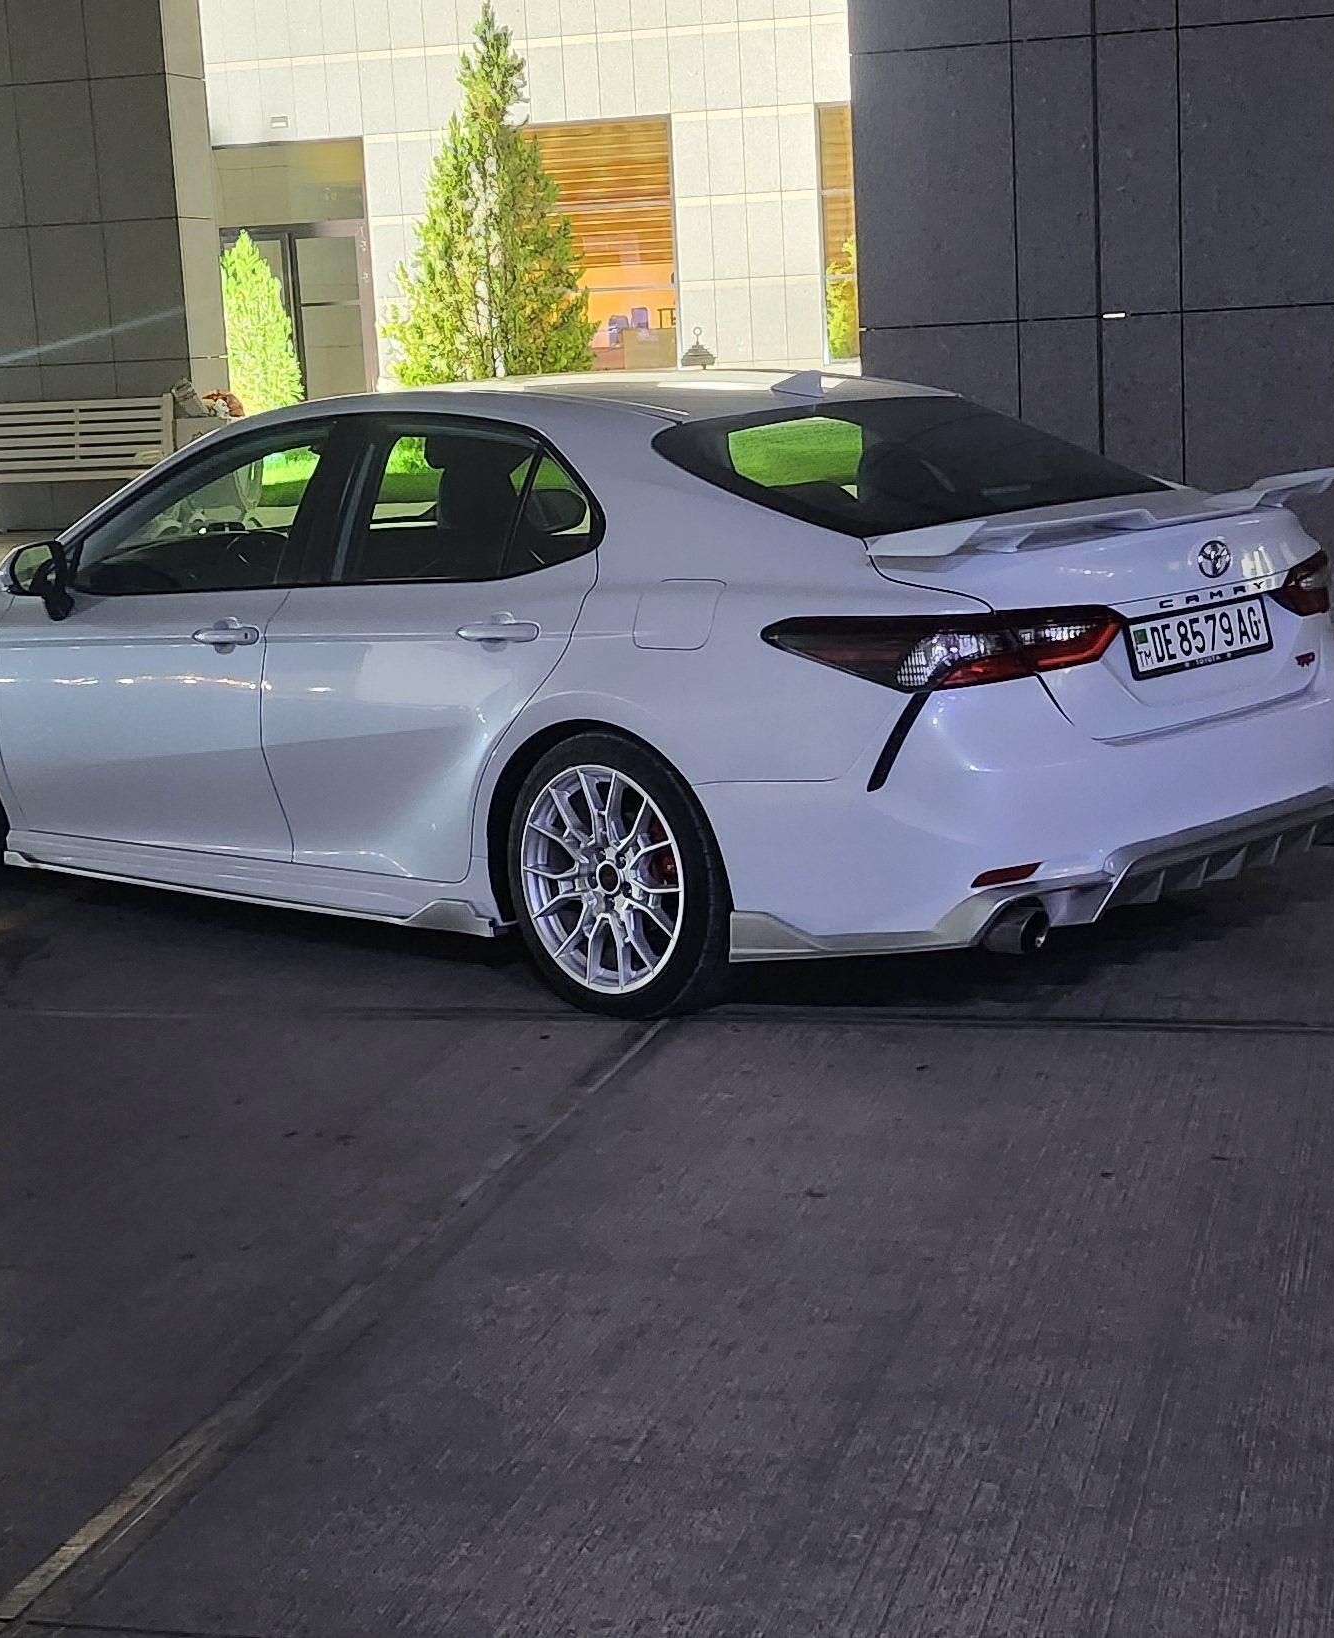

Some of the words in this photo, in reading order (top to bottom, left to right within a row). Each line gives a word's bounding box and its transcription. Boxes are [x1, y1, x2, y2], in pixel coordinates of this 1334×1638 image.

[1159, 581, 1264, 609] CAMRY
[1150, 623, 1177, 663] DE
[1177, 611, 1235, 657] 8579
[1237, 606, 1261, 645] AG
[1137, 649, 1155, 668] TM
